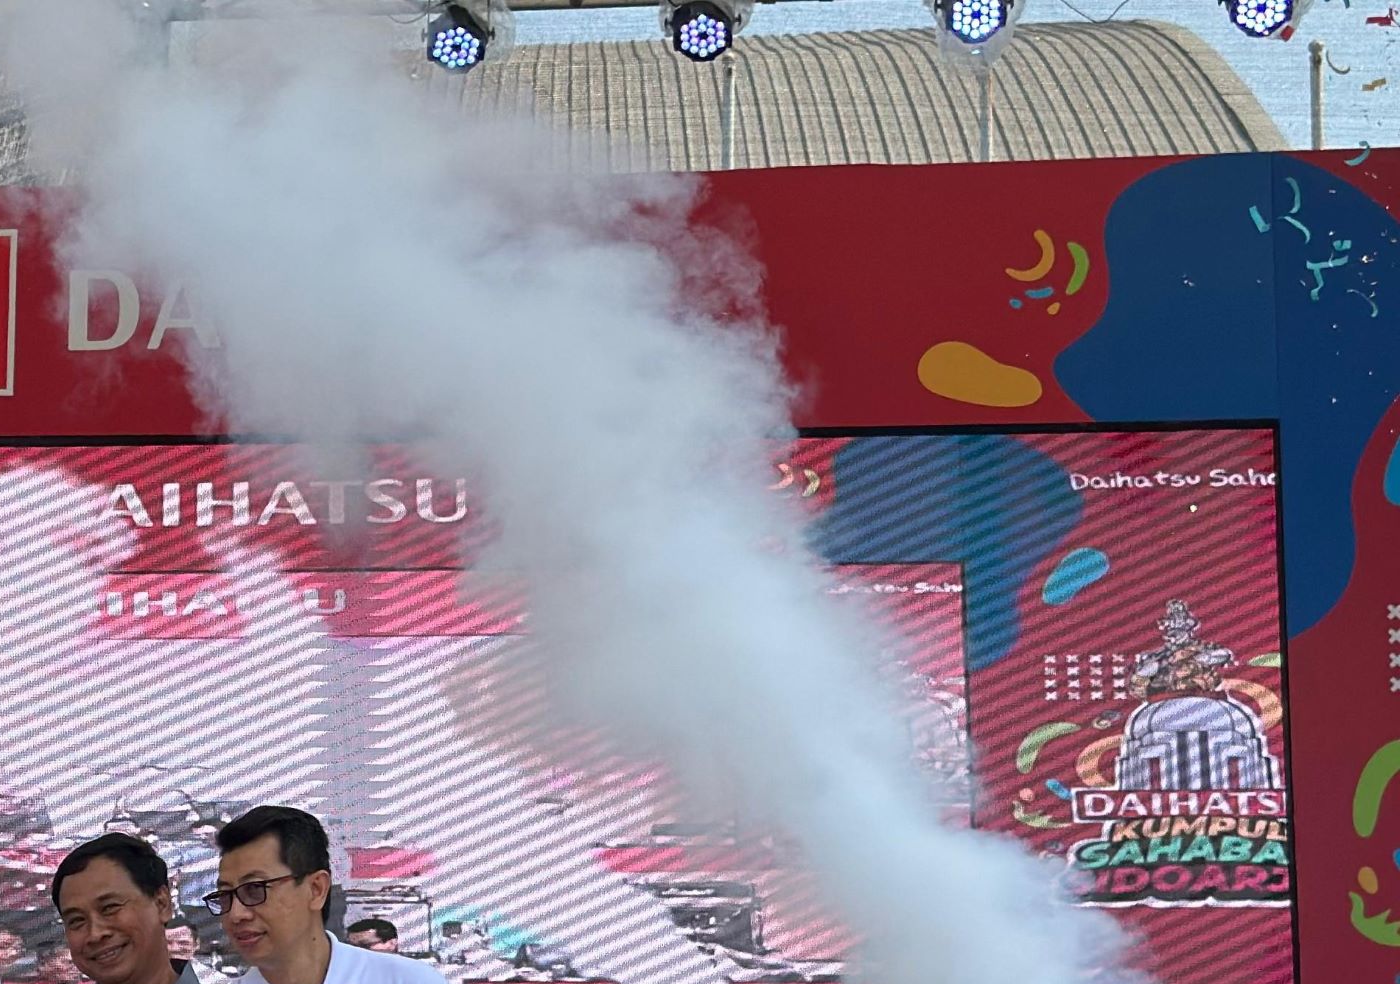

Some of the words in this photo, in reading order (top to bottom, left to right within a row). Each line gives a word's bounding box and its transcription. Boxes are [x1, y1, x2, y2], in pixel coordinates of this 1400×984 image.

[1070, 470, 1201, 491] Daihatsu
[102, 478, 468, 527] AIHATSU
[1084, 792, 1288, 817] DAIHATS
